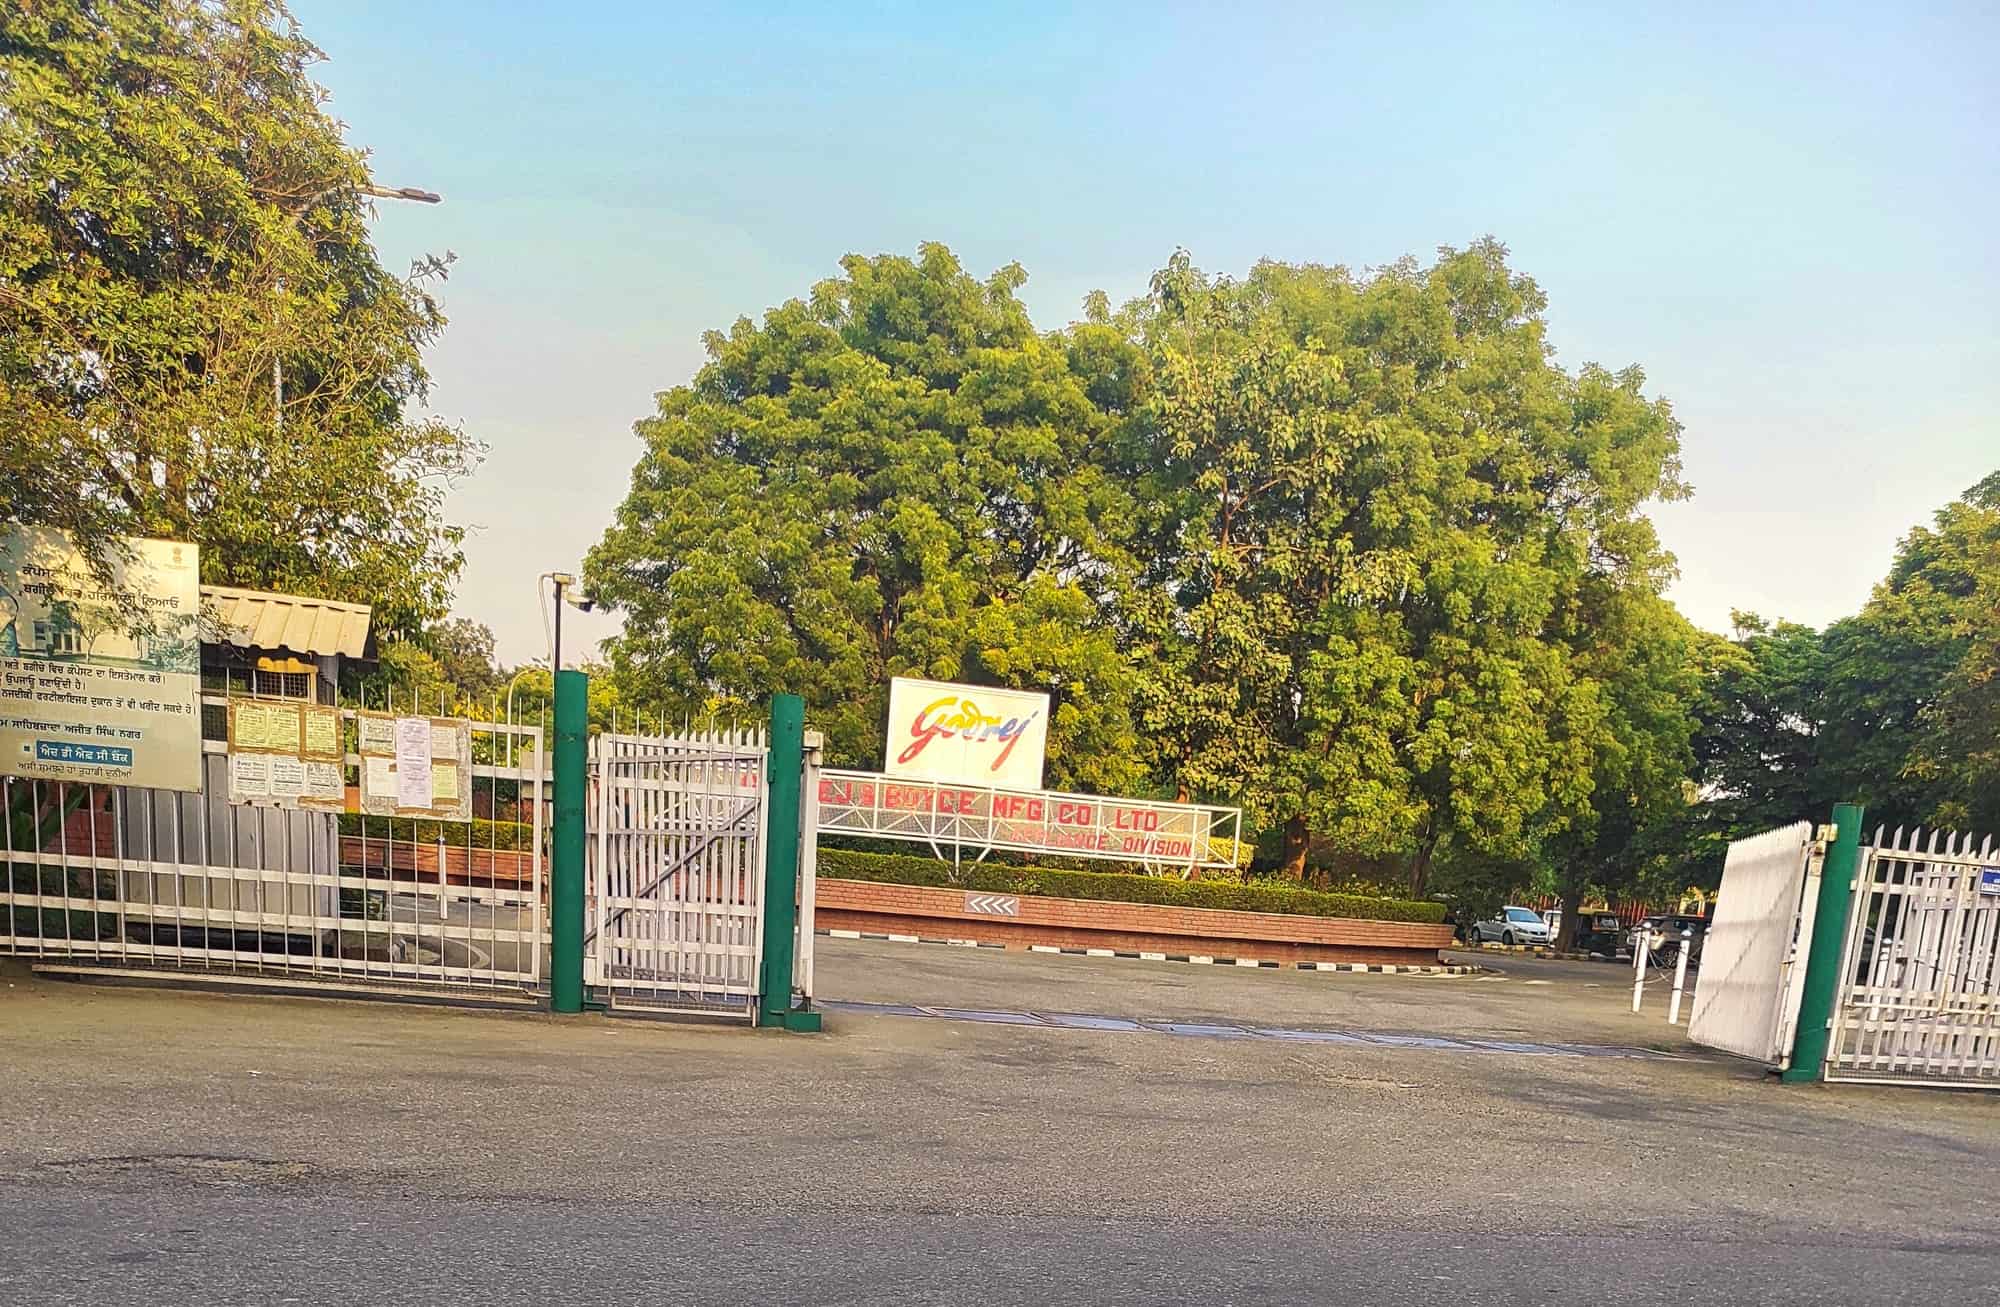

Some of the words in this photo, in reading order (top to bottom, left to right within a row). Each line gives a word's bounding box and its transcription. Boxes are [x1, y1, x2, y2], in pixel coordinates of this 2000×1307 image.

[897, 695, 1039, 771] Godrej
[992, 795, 1043, 821] MFG
[1057, 803, 1092, 826] CO
[1122, 836, 1192, 857] DIVISION
